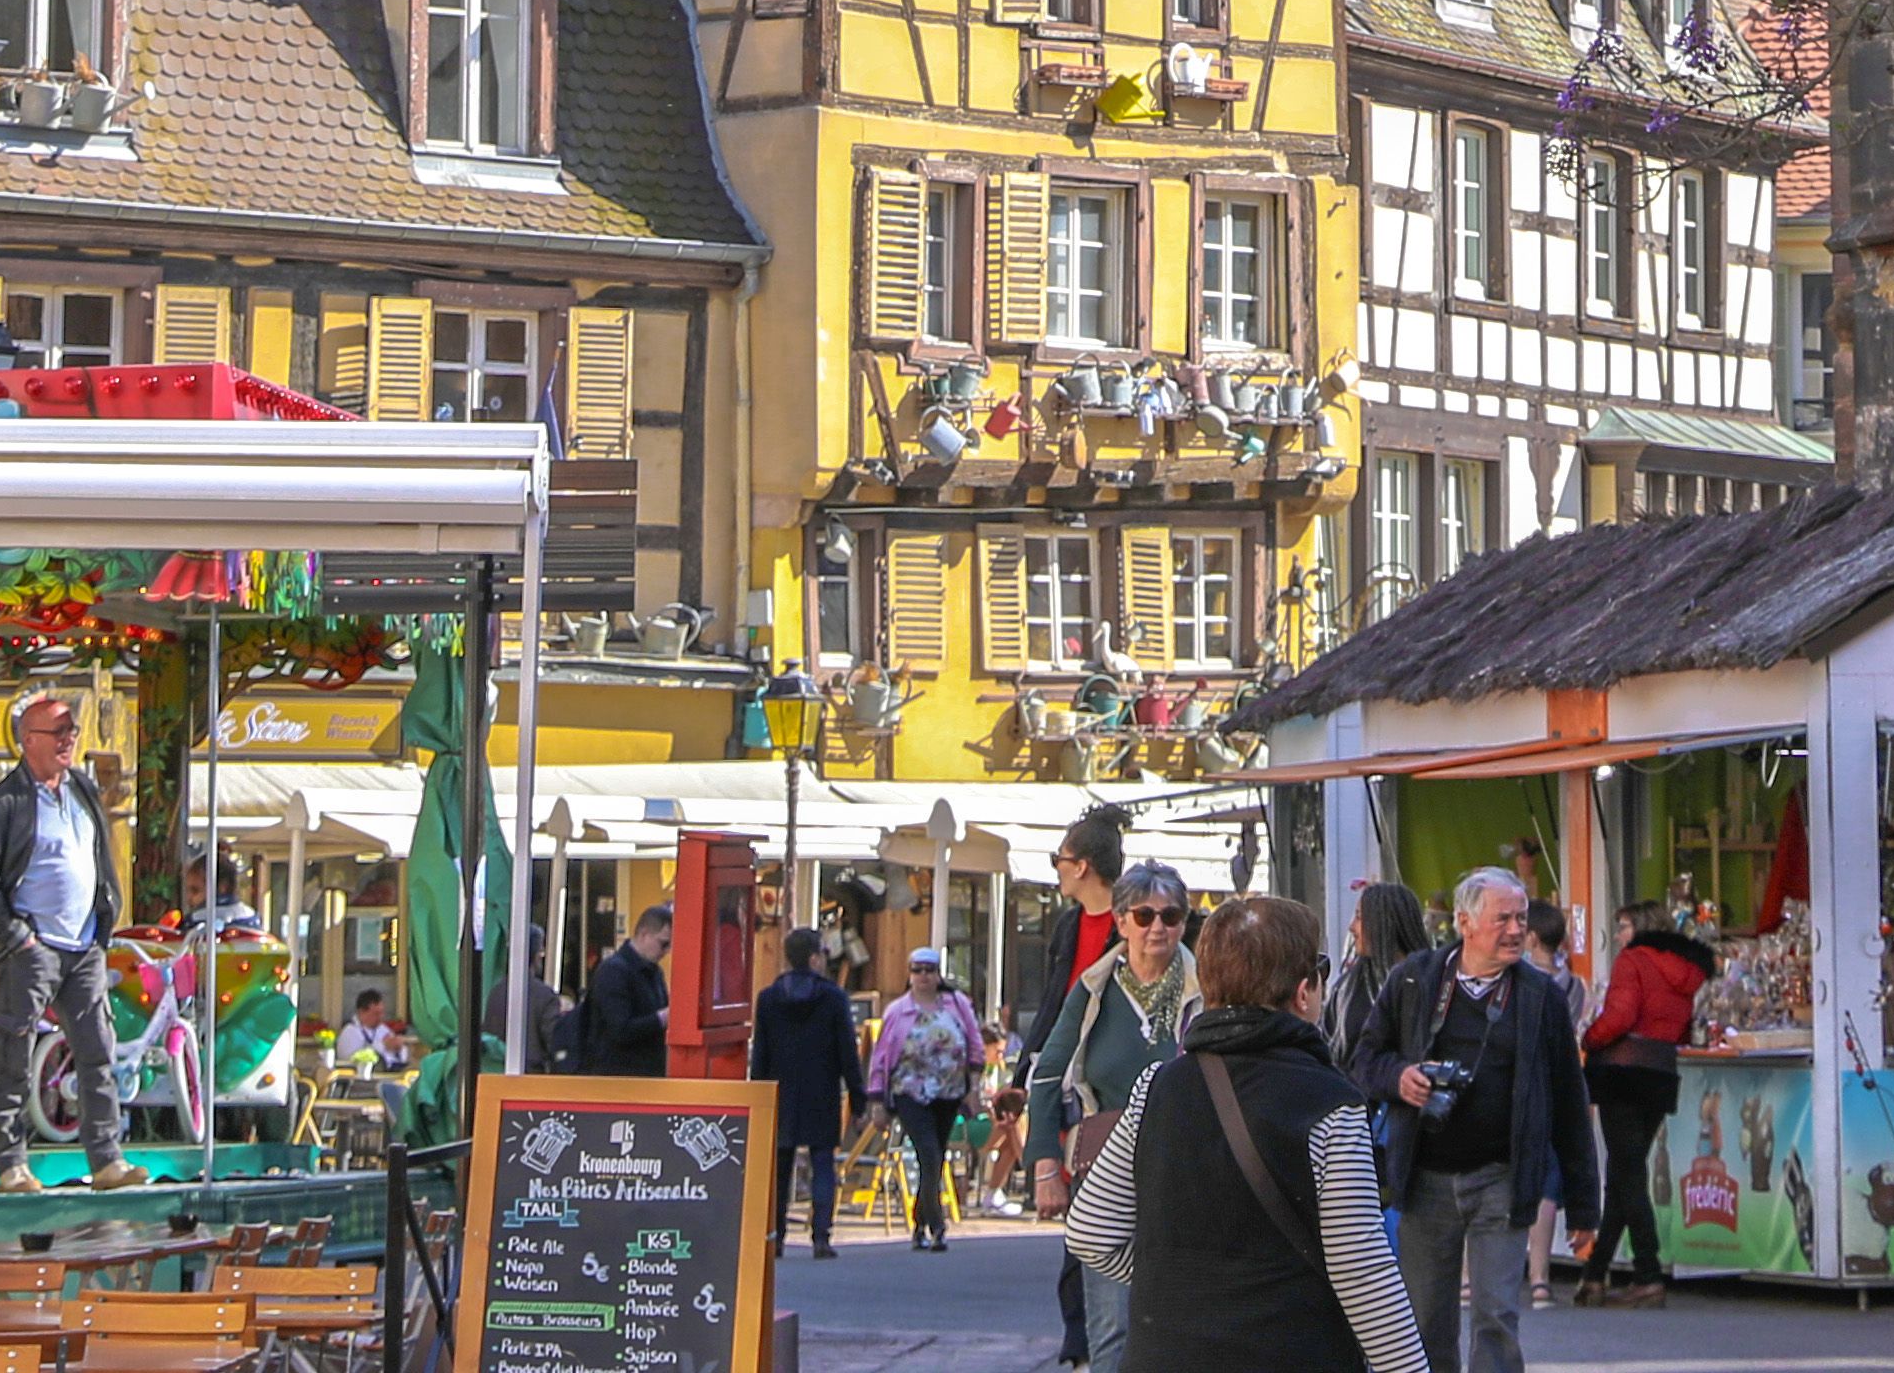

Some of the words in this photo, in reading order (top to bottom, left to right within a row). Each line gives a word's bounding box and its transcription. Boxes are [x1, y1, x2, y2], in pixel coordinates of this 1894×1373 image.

[579, 1150, 662, 1180] Kronenbourg
[528, 1178, 559, 1199] Nos
[560, 1176, 611, 1199] Bières
[520, 1202, 563, 1218] TAAL
[507, 1235, 538, 1253] Pale
[542, 1239, 565, 1255] Ale
[505, 1257, 545, 1280] Neipa
[628, 1258, 679, 1275] Blonde
[503, 1274, 559, 1292] Weisen
[627, 1278, 674, 1297] Brune
[625, 1298, 680, 1318] Ambrée
[495, 1313, 534, 1326] Autres
[625, 1321, 657, 1346] Hop
[501, 1337, 532, 1355] Perle
[534, 1342, 562, 1358] IPA
[624, 1345, 678, 1365] Saison
